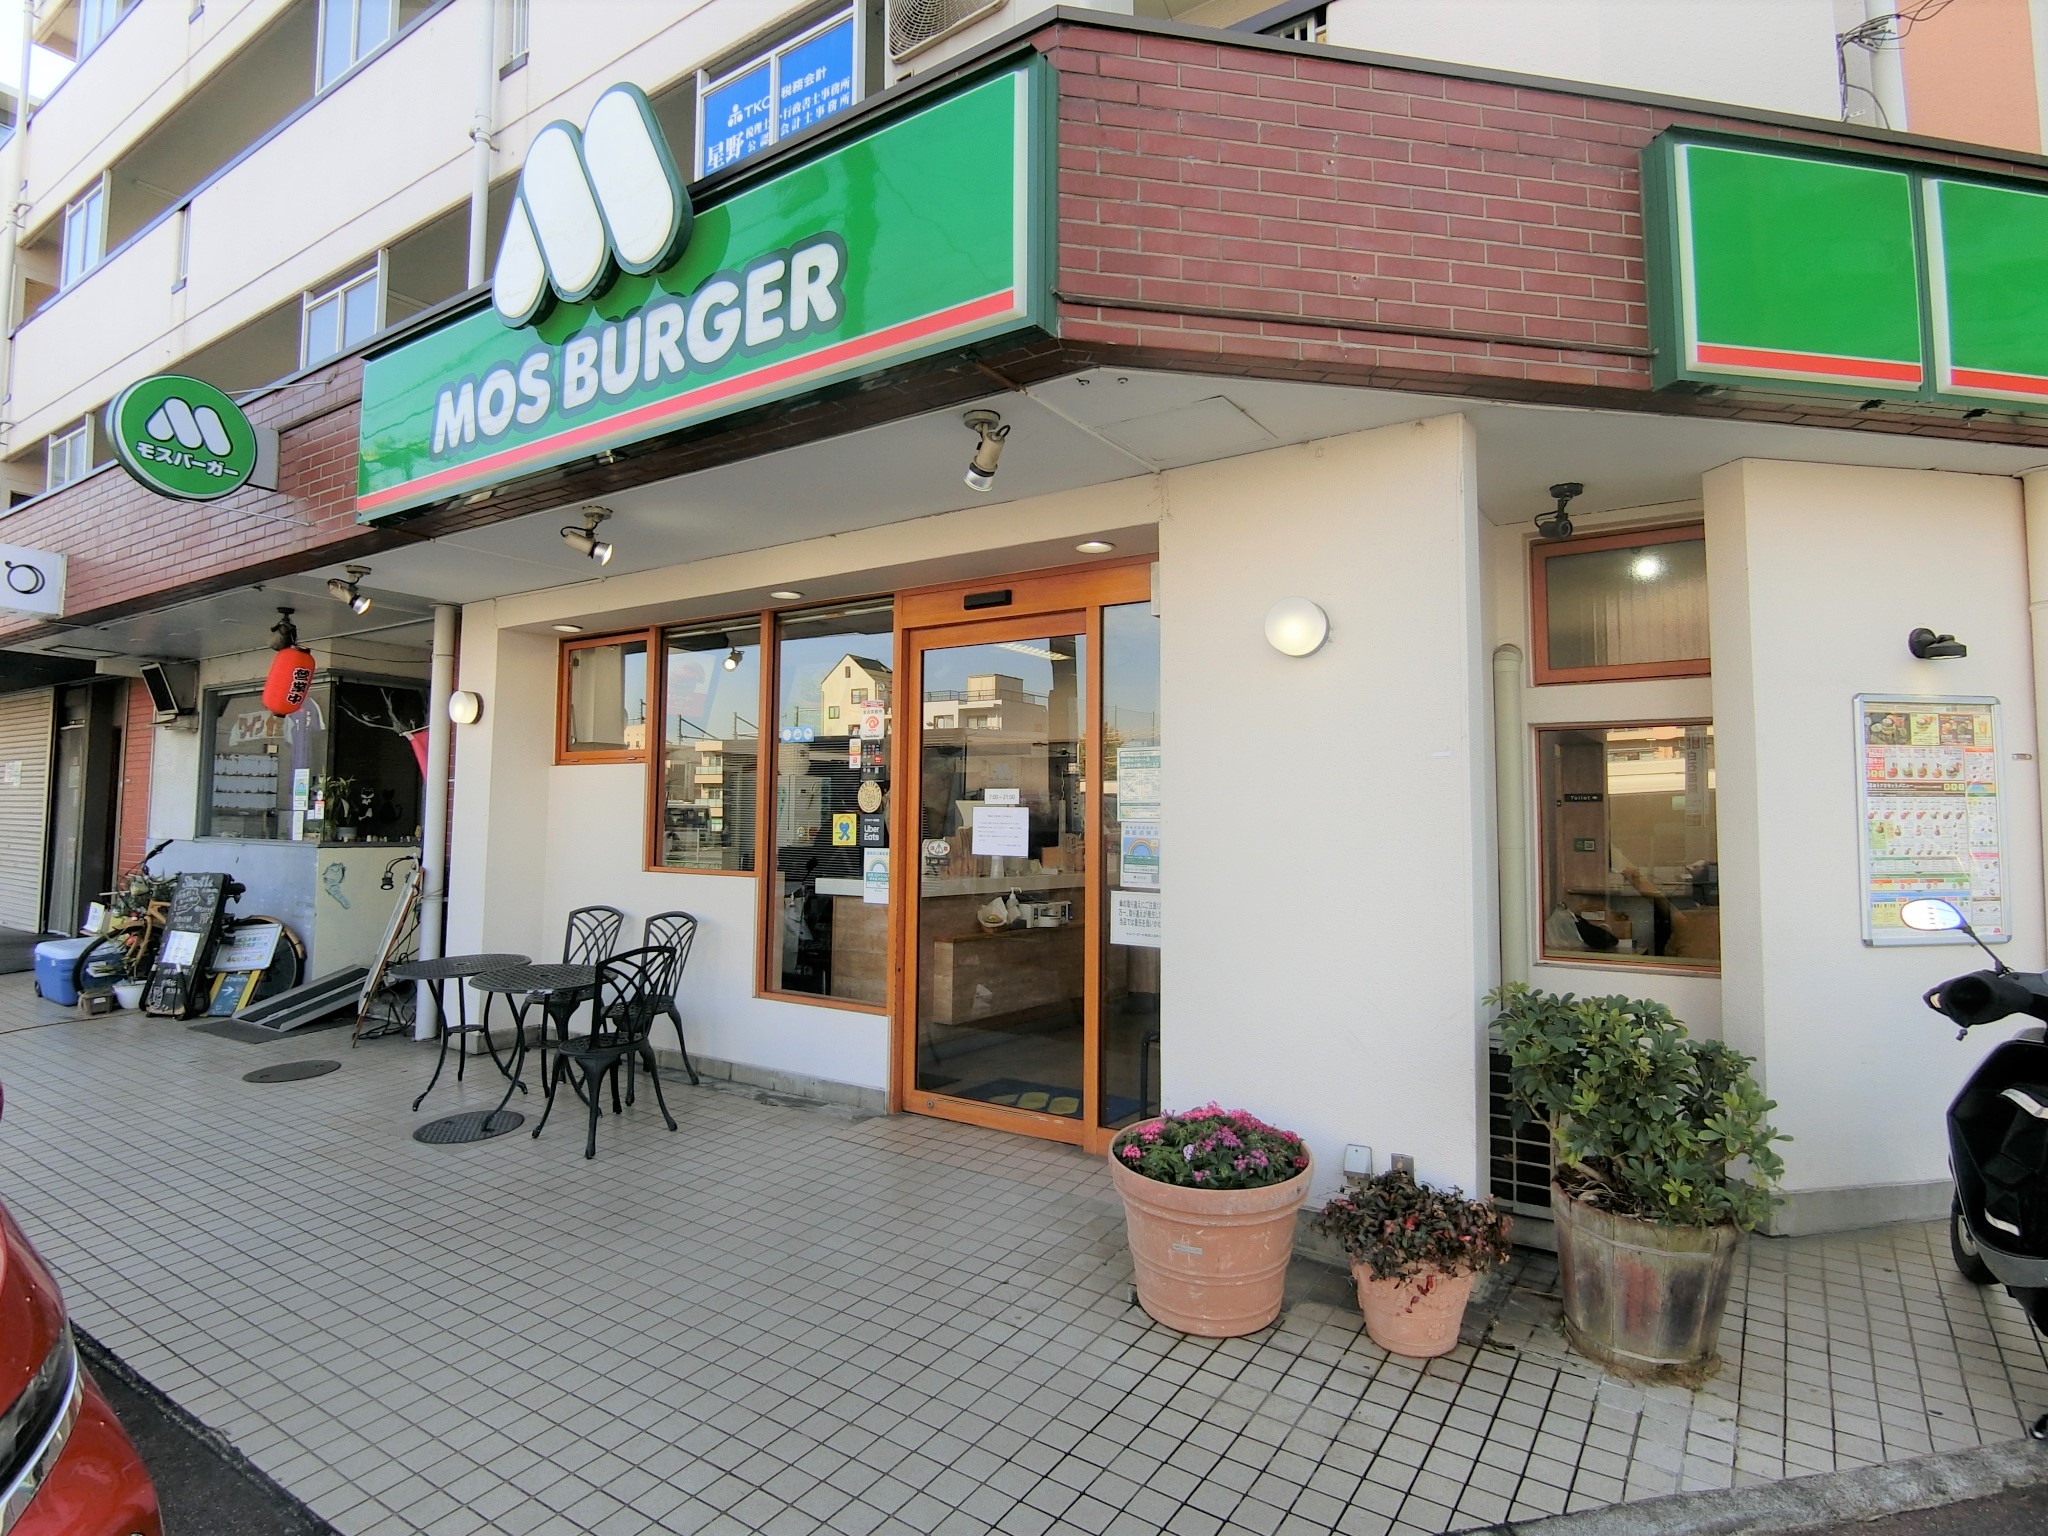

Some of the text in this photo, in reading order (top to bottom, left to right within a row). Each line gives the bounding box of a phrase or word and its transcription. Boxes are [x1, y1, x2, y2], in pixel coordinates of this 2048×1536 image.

[706, 131, 744, 169] 星野
[432, 243, 839, 454] MOS BURGER
[136, 441, 239, 477] モスバーガー
[287, 668, 310, 705] 営業中
[863, 824, 880, 833] Uber
[863, 832, 880, 841] Eats
